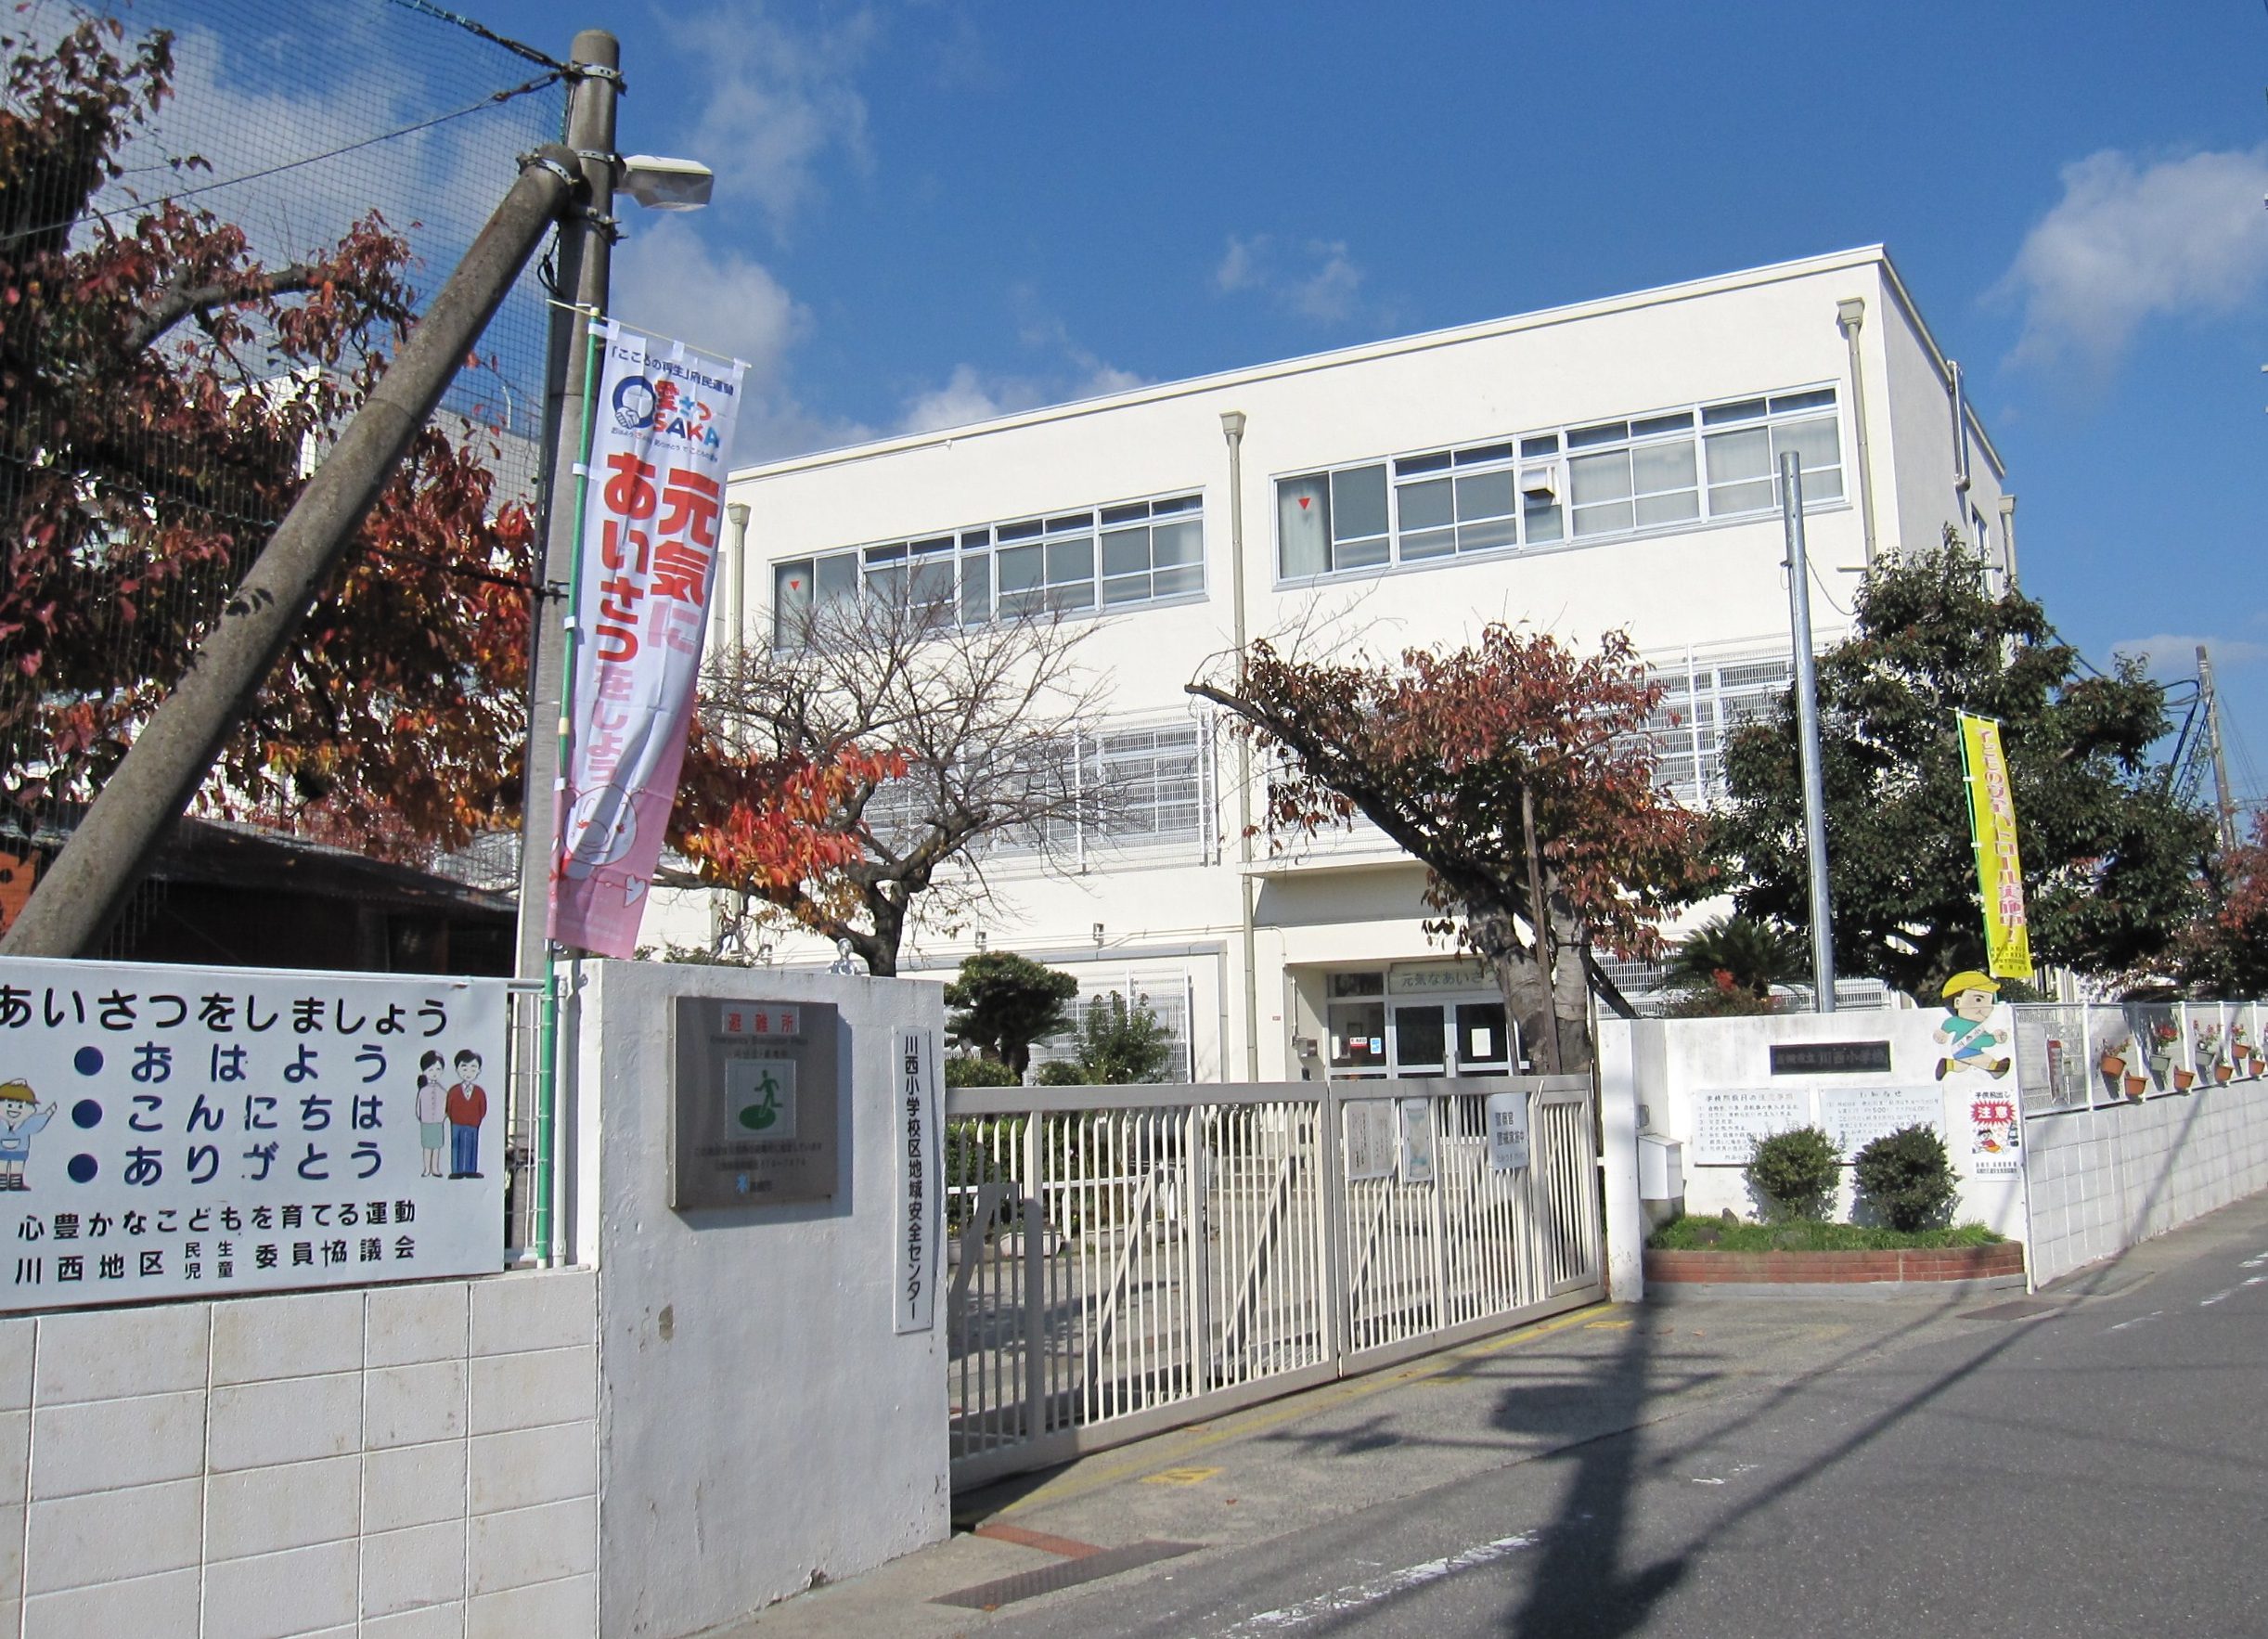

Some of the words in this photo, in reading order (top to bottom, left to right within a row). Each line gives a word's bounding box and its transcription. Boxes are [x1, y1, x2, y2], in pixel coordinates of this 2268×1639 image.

[647, 468, 720, 655] 元気に
[1402, 971, 1494, 987] 元気なあいさ
[0, 985, 447, 1037] あいさつをしましょう
[728, 1013, 793, 1033] 避難所
[131, 1040, 388, 1084] おはよう
[128, 1093, 383, 1133] こんにちは
[1978, 1105, 2009, 1119] 注意
[123, 1142, 383, 1187] ありがとう
[905, 1035, 922, 1321] 川西小学校区地域安全センター
[17, 1199, 417, 1240] 心豊かなこどもを育てる運動
